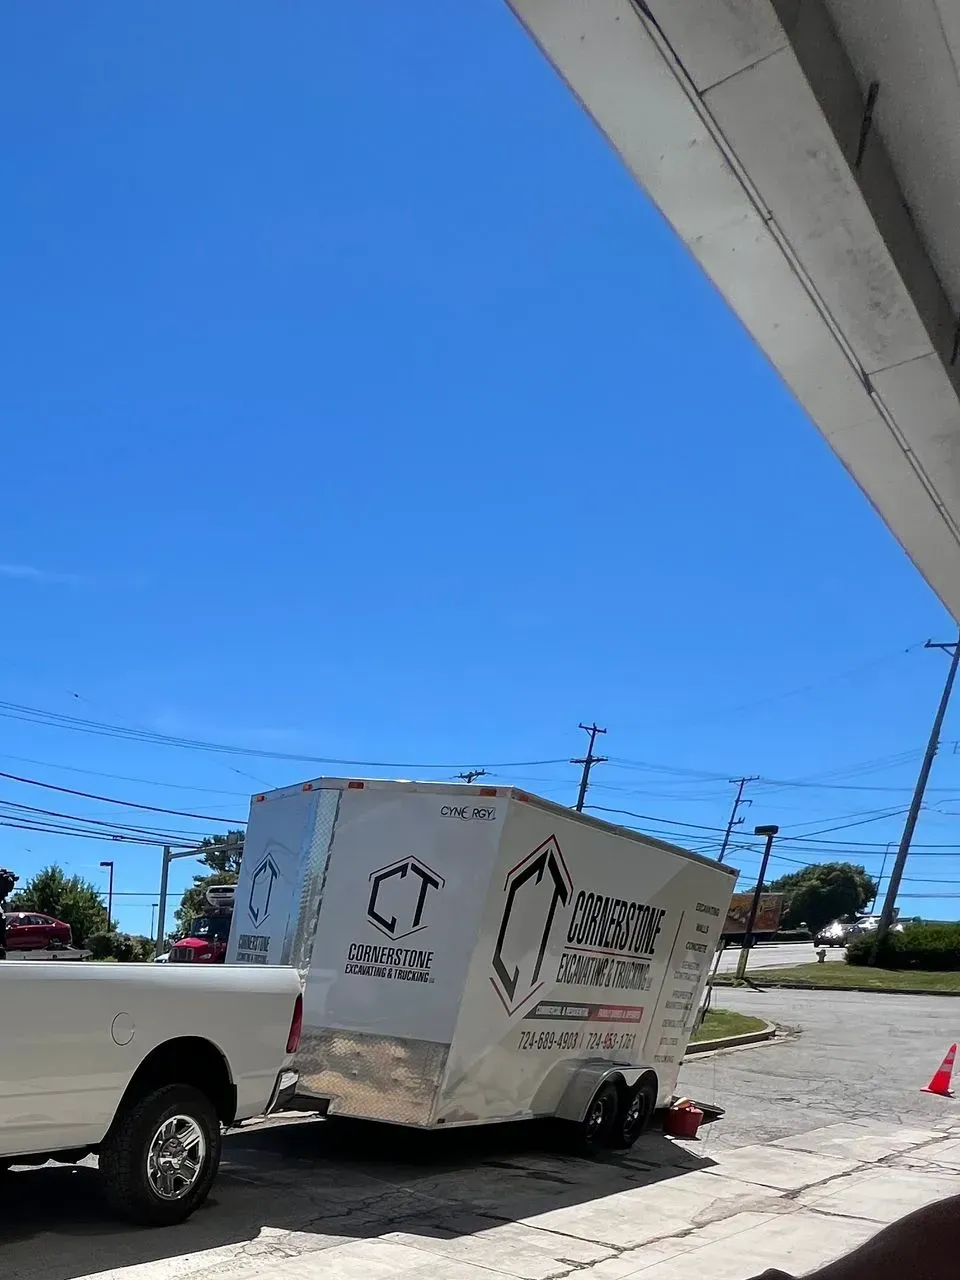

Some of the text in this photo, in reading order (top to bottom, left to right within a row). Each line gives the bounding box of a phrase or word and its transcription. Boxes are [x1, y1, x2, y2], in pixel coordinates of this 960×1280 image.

[567, 890, 666, 955] CORNERSTONE
[348, 943, 434, 969] CORNERSTONE
[345, 964, 387, 978] EXCAVATING
[387, 968, 393, 978] &
[394, 969, 430, 983] TRUCKING
[556, 953, 608, 988] EXCAVATING
[518, 1032, 578, 1049] 724-689-4903
